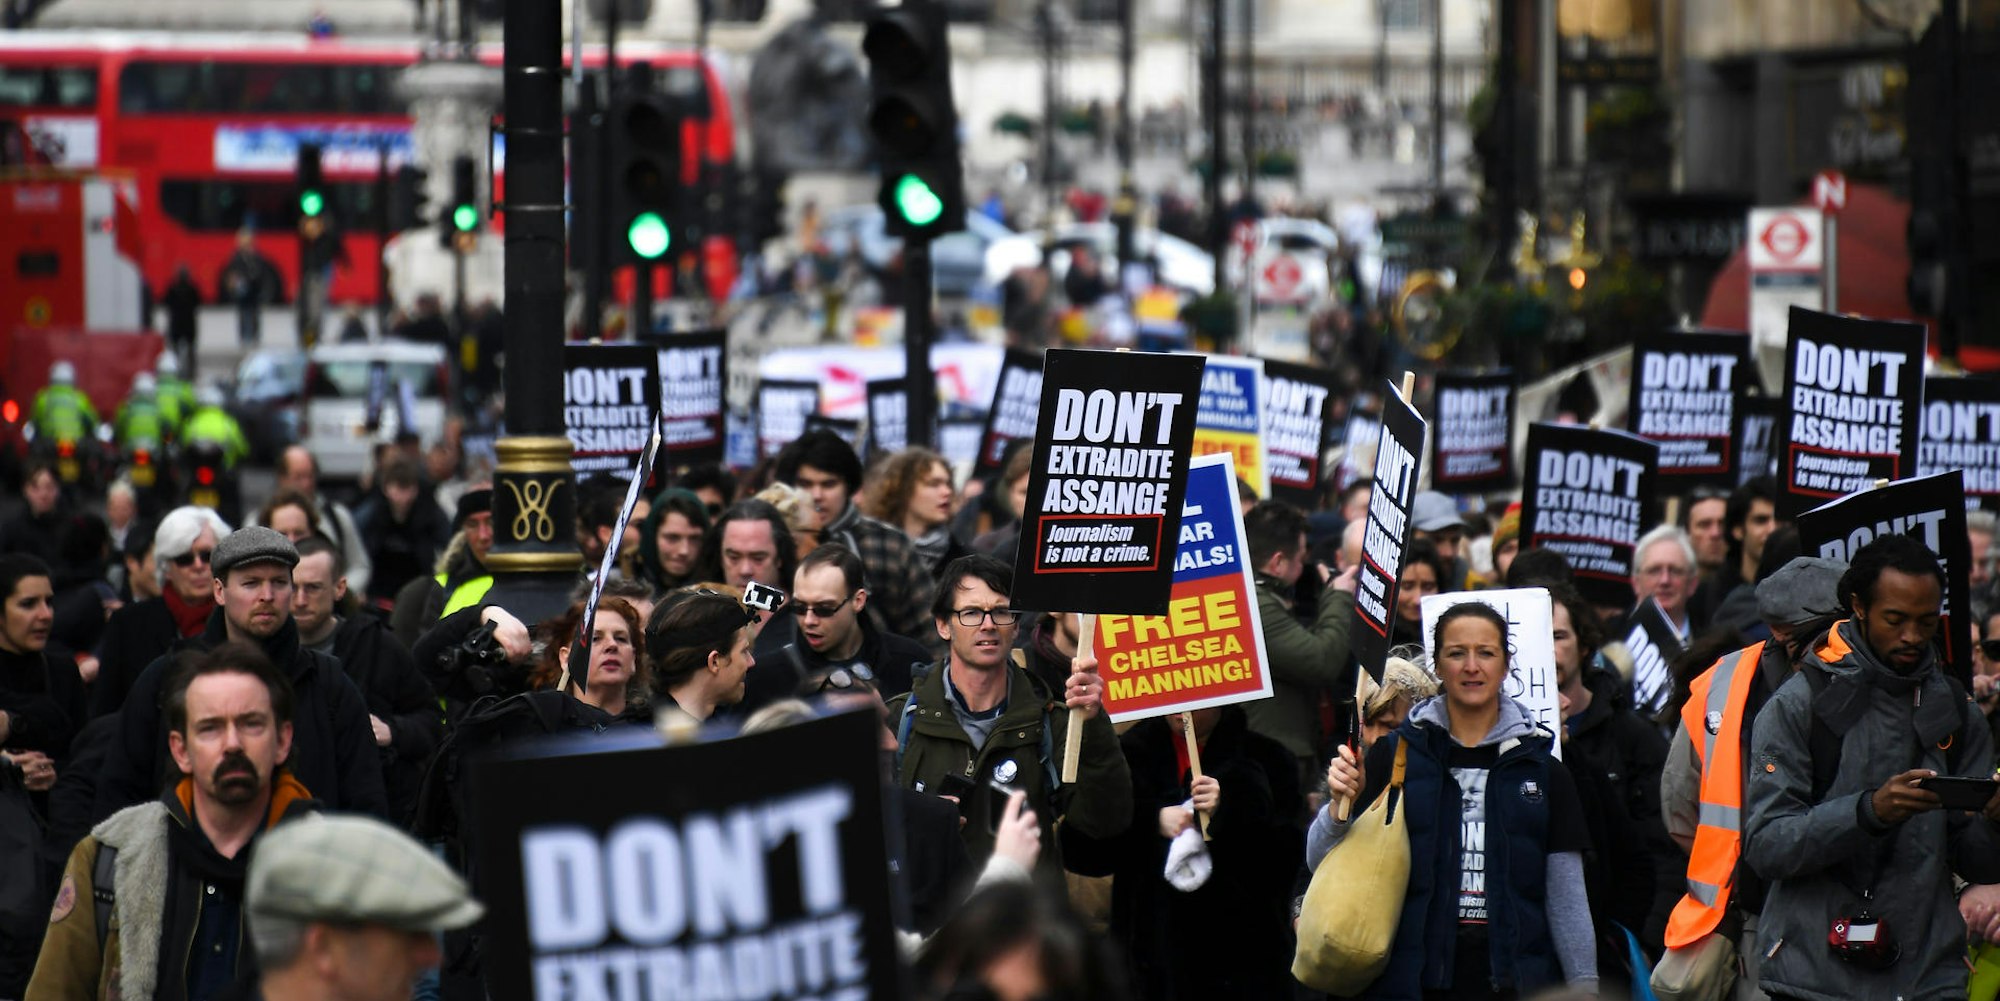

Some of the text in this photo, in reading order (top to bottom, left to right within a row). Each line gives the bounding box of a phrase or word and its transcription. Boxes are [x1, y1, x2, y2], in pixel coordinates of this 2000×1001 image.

[1203, 370, 1243, 396] AIL
[1642, 353, 1738, 391] DON'T
[1795, 338, 1907, 397] DON'T
[1052, 388, 1183, 444] DON'T
[1640, 390, 1733, 413] EXTRADITE
[1793, 385, 1903, 425] EXTRADITE
[1922, 400, 2000, 441] ON'T
[1639, 411, 1731, 436] ASSANGE
[1791, 415, 1902, 456] ASSANGE
[1048, 445, 1174, 479] EXTRADITE
[1375, 424, 1415, 508] DON'T
[1538, 450, 1645, 498] DON'T
[1797, 452, 1869, 475] Journalism
[1042, 478, 1169, 516] ASSANGE
[1536, 488, 1641, 520] EXTRADITE
[1047, 524, 1134, 543] Journalism
[1179, 521, 1215, 545] AR
[1535, 510, 1639, 545] ASSANGE
[1045, 544, 1150, 563] is not a crime.
[1100, 590, 1241, 649] FREE
[1110, 634, 1244, 674] CHELSEA
[1108, 658, 1252, 702] MANNING!
[521, 783, 853, 950] DON'T
